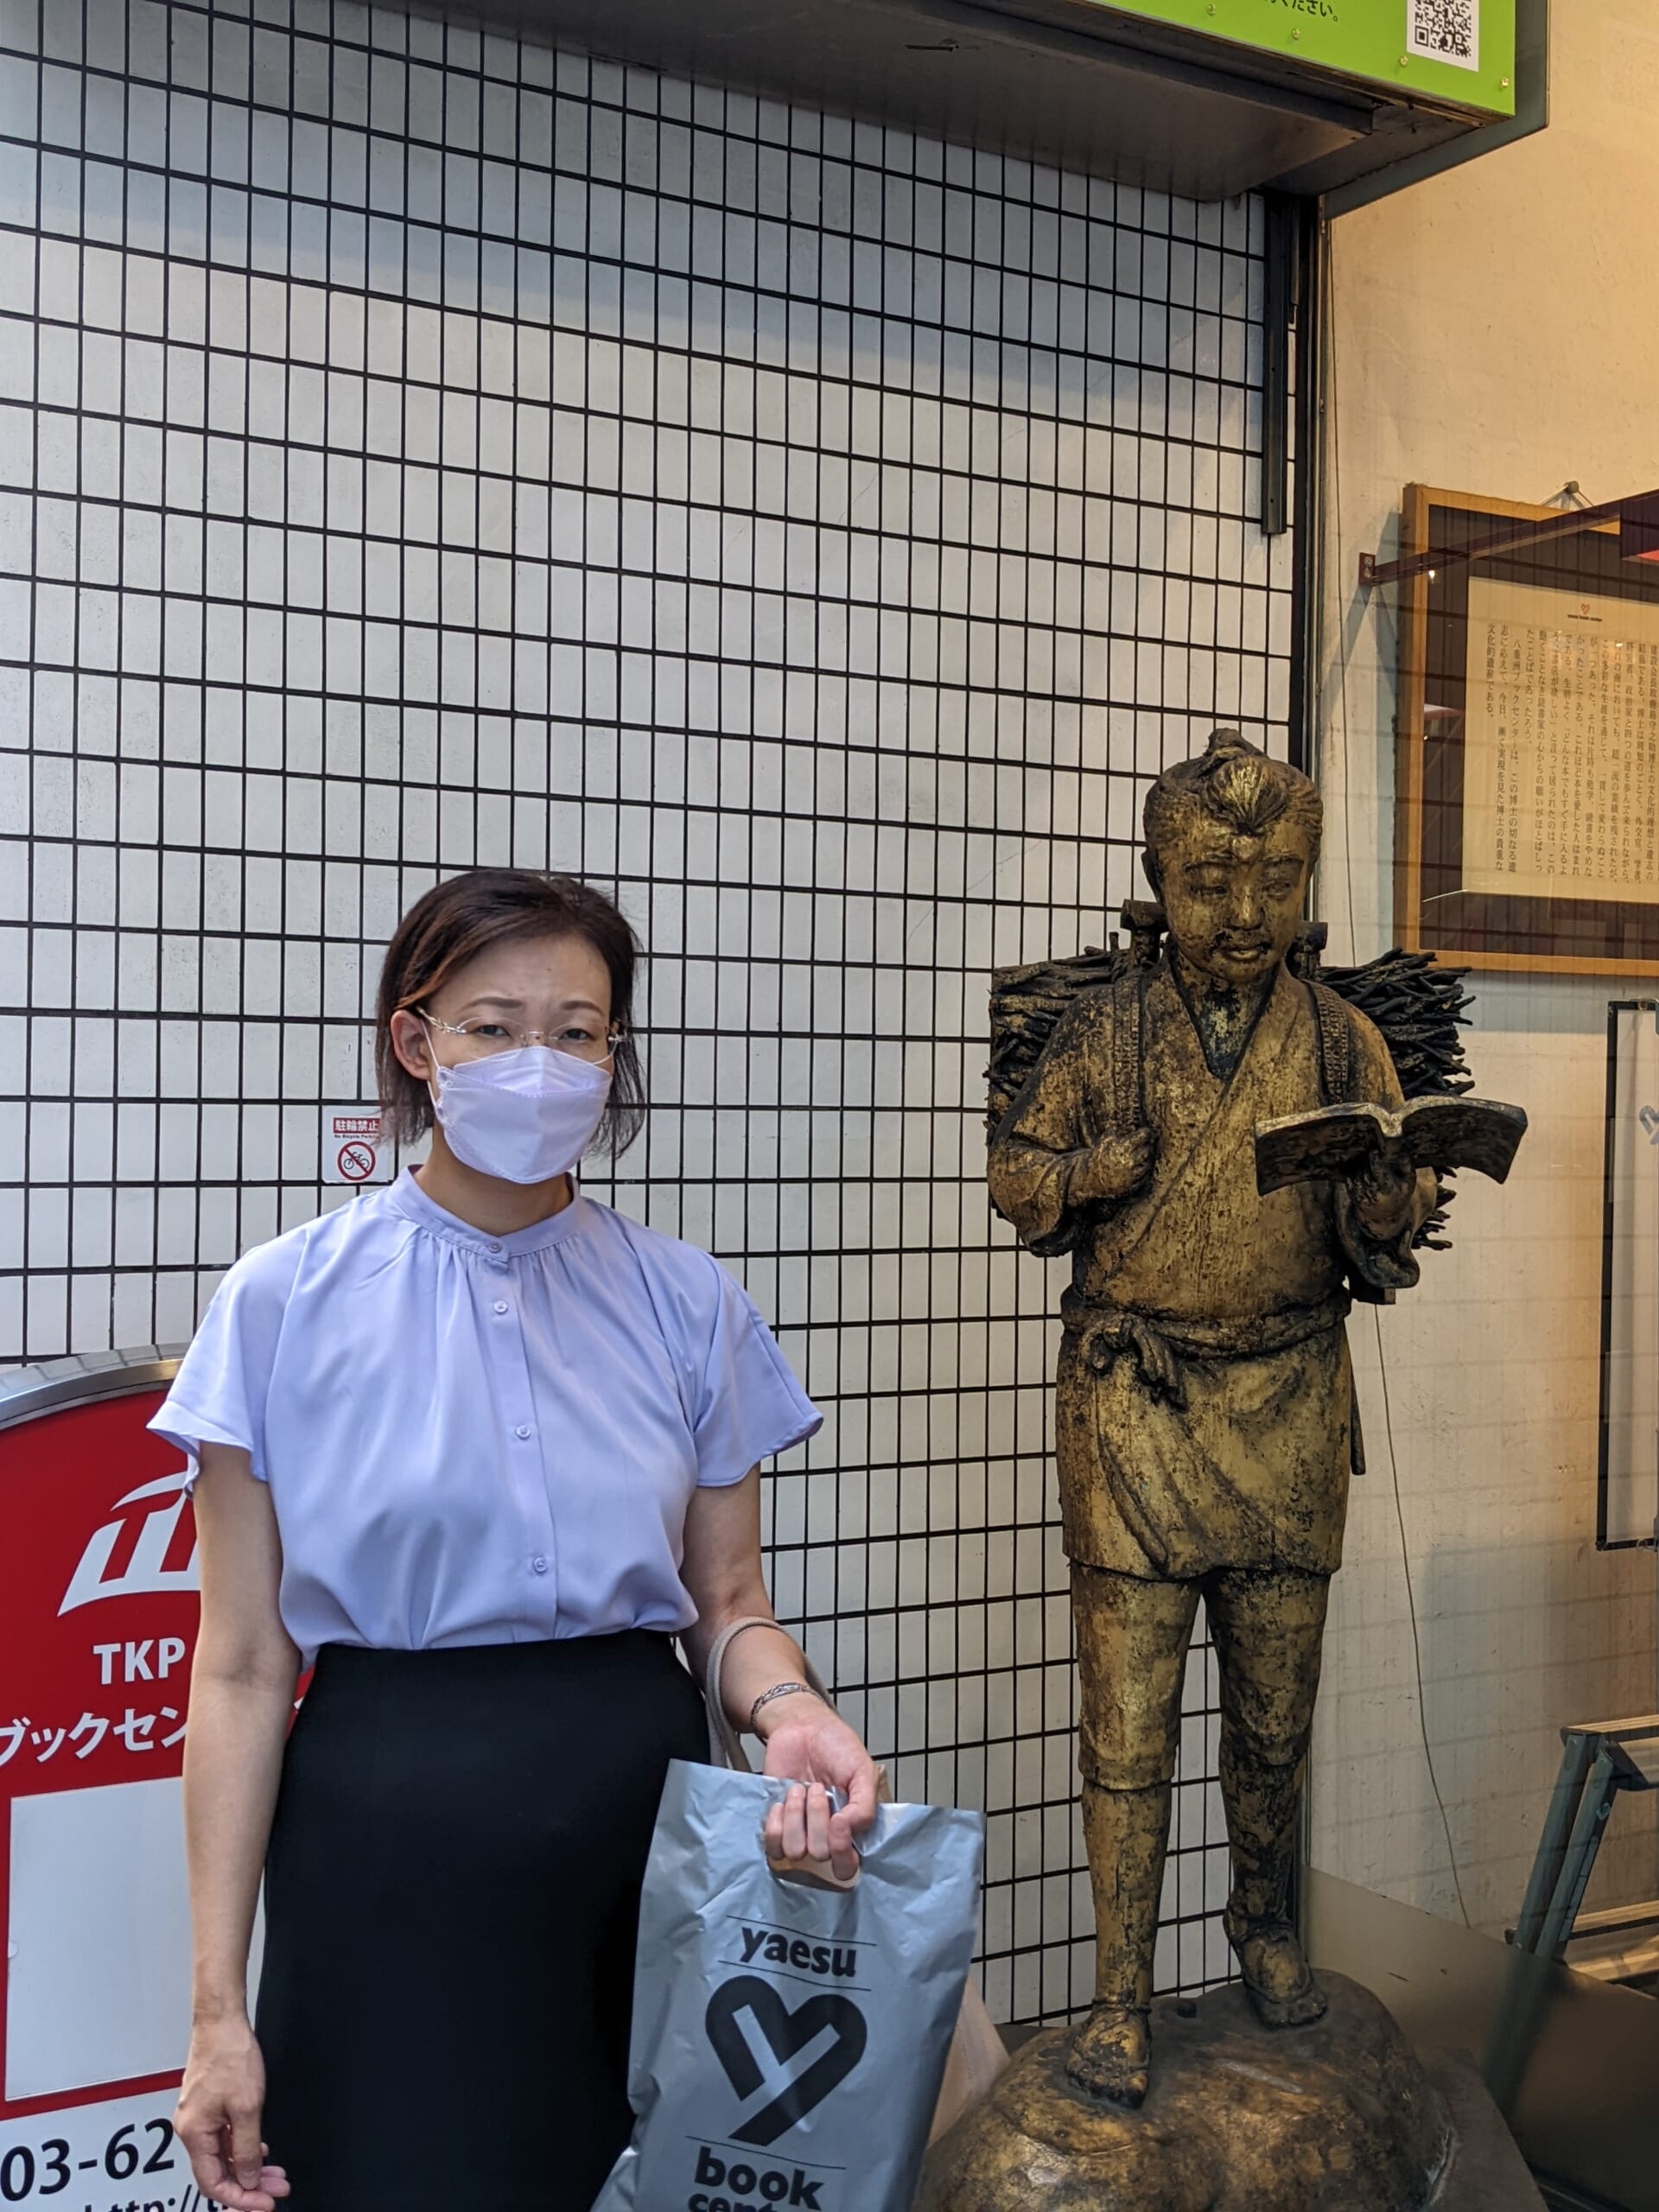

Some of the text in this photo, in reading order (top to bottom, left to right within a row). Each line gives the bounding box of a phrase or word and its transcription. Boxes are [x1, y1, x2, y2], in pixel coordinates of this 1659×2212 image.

[1265, 0, 1338, 22] ださい。
[335, 1119, 378, 1132] 駐輪禁止
[92, 1636, 186, 1686] TKP
[0, 1706, 188, 1768] ブックセン
[739, 1926, 858, 1978] yaesu
[0, 2117, 175, 2202] 03-62
[694, 2145, 825, 2211] book
